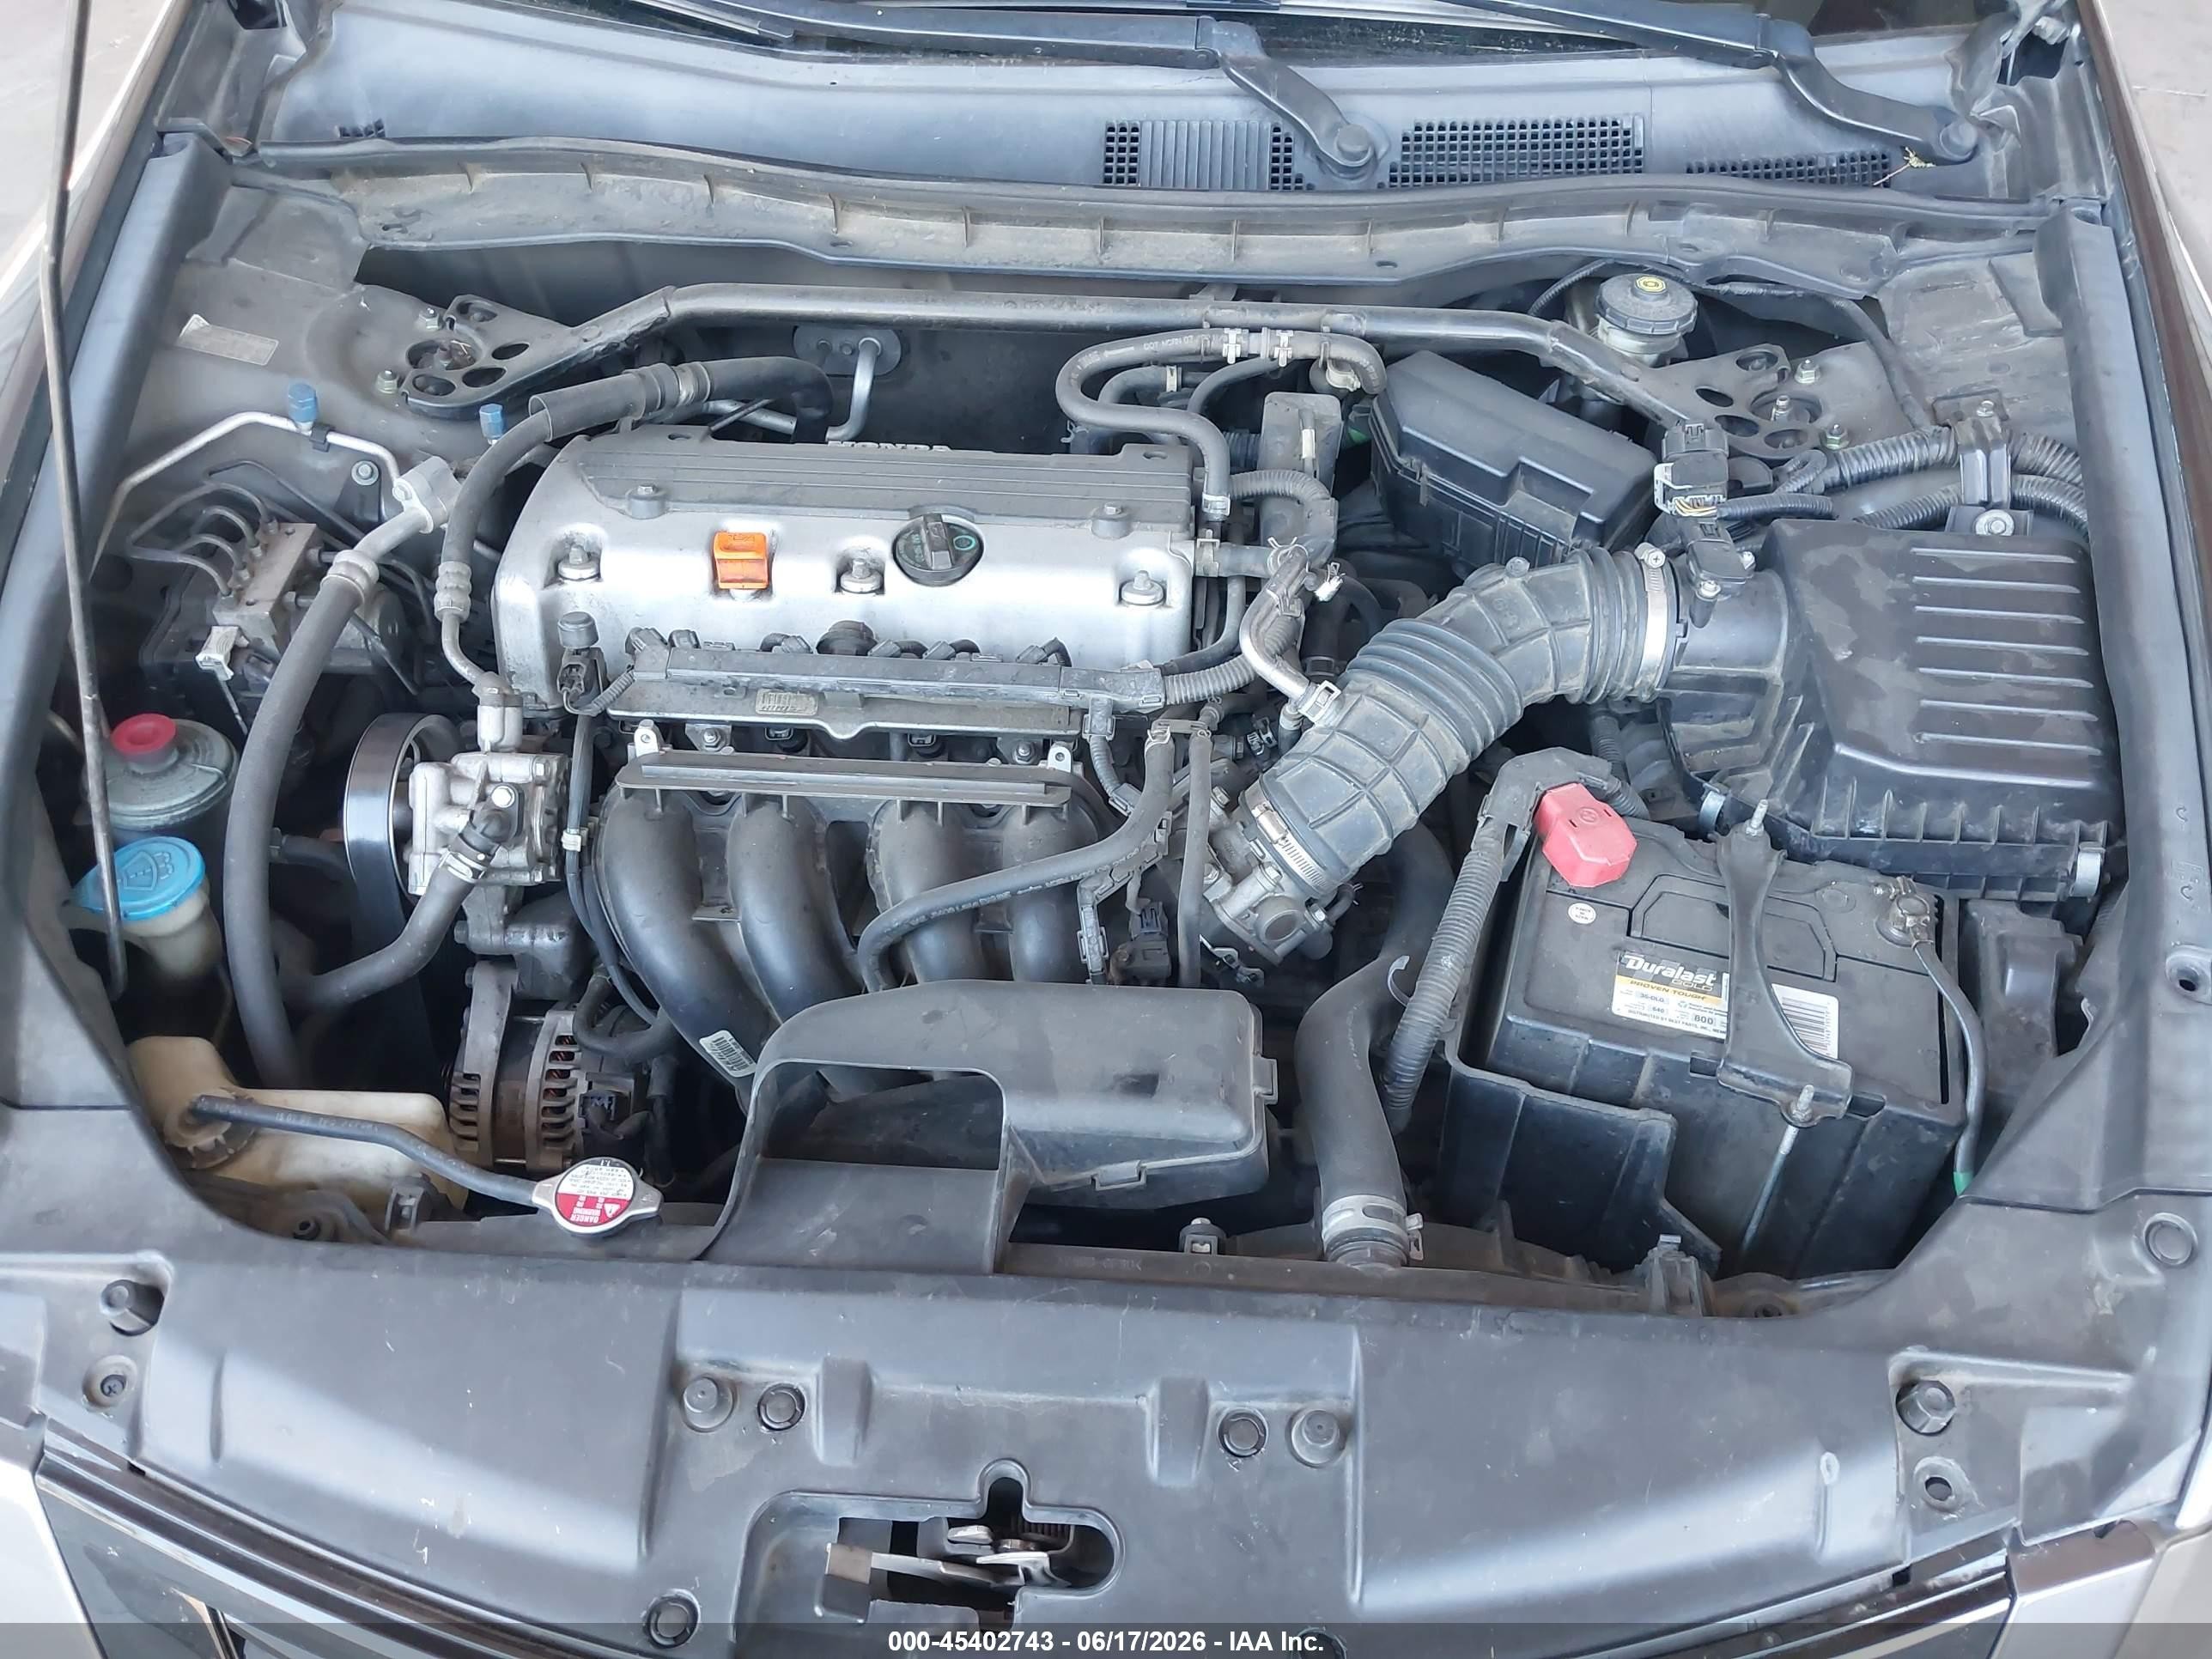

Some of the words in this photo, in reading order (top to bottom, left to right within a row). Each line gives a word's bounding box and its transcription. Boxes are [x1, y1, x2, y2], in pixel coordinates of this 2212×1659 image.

[1623, 954, 1717, 987] Duralast
[1630, 980, 1670, 993] PROVEN
[1672, 989, 1707, 1001] TOUGH
[1671, 979, 1713, 992] GOLD
[1694, 1014, 1714, 1025] 800
[569, 1213, 599, 1224] DANGER
